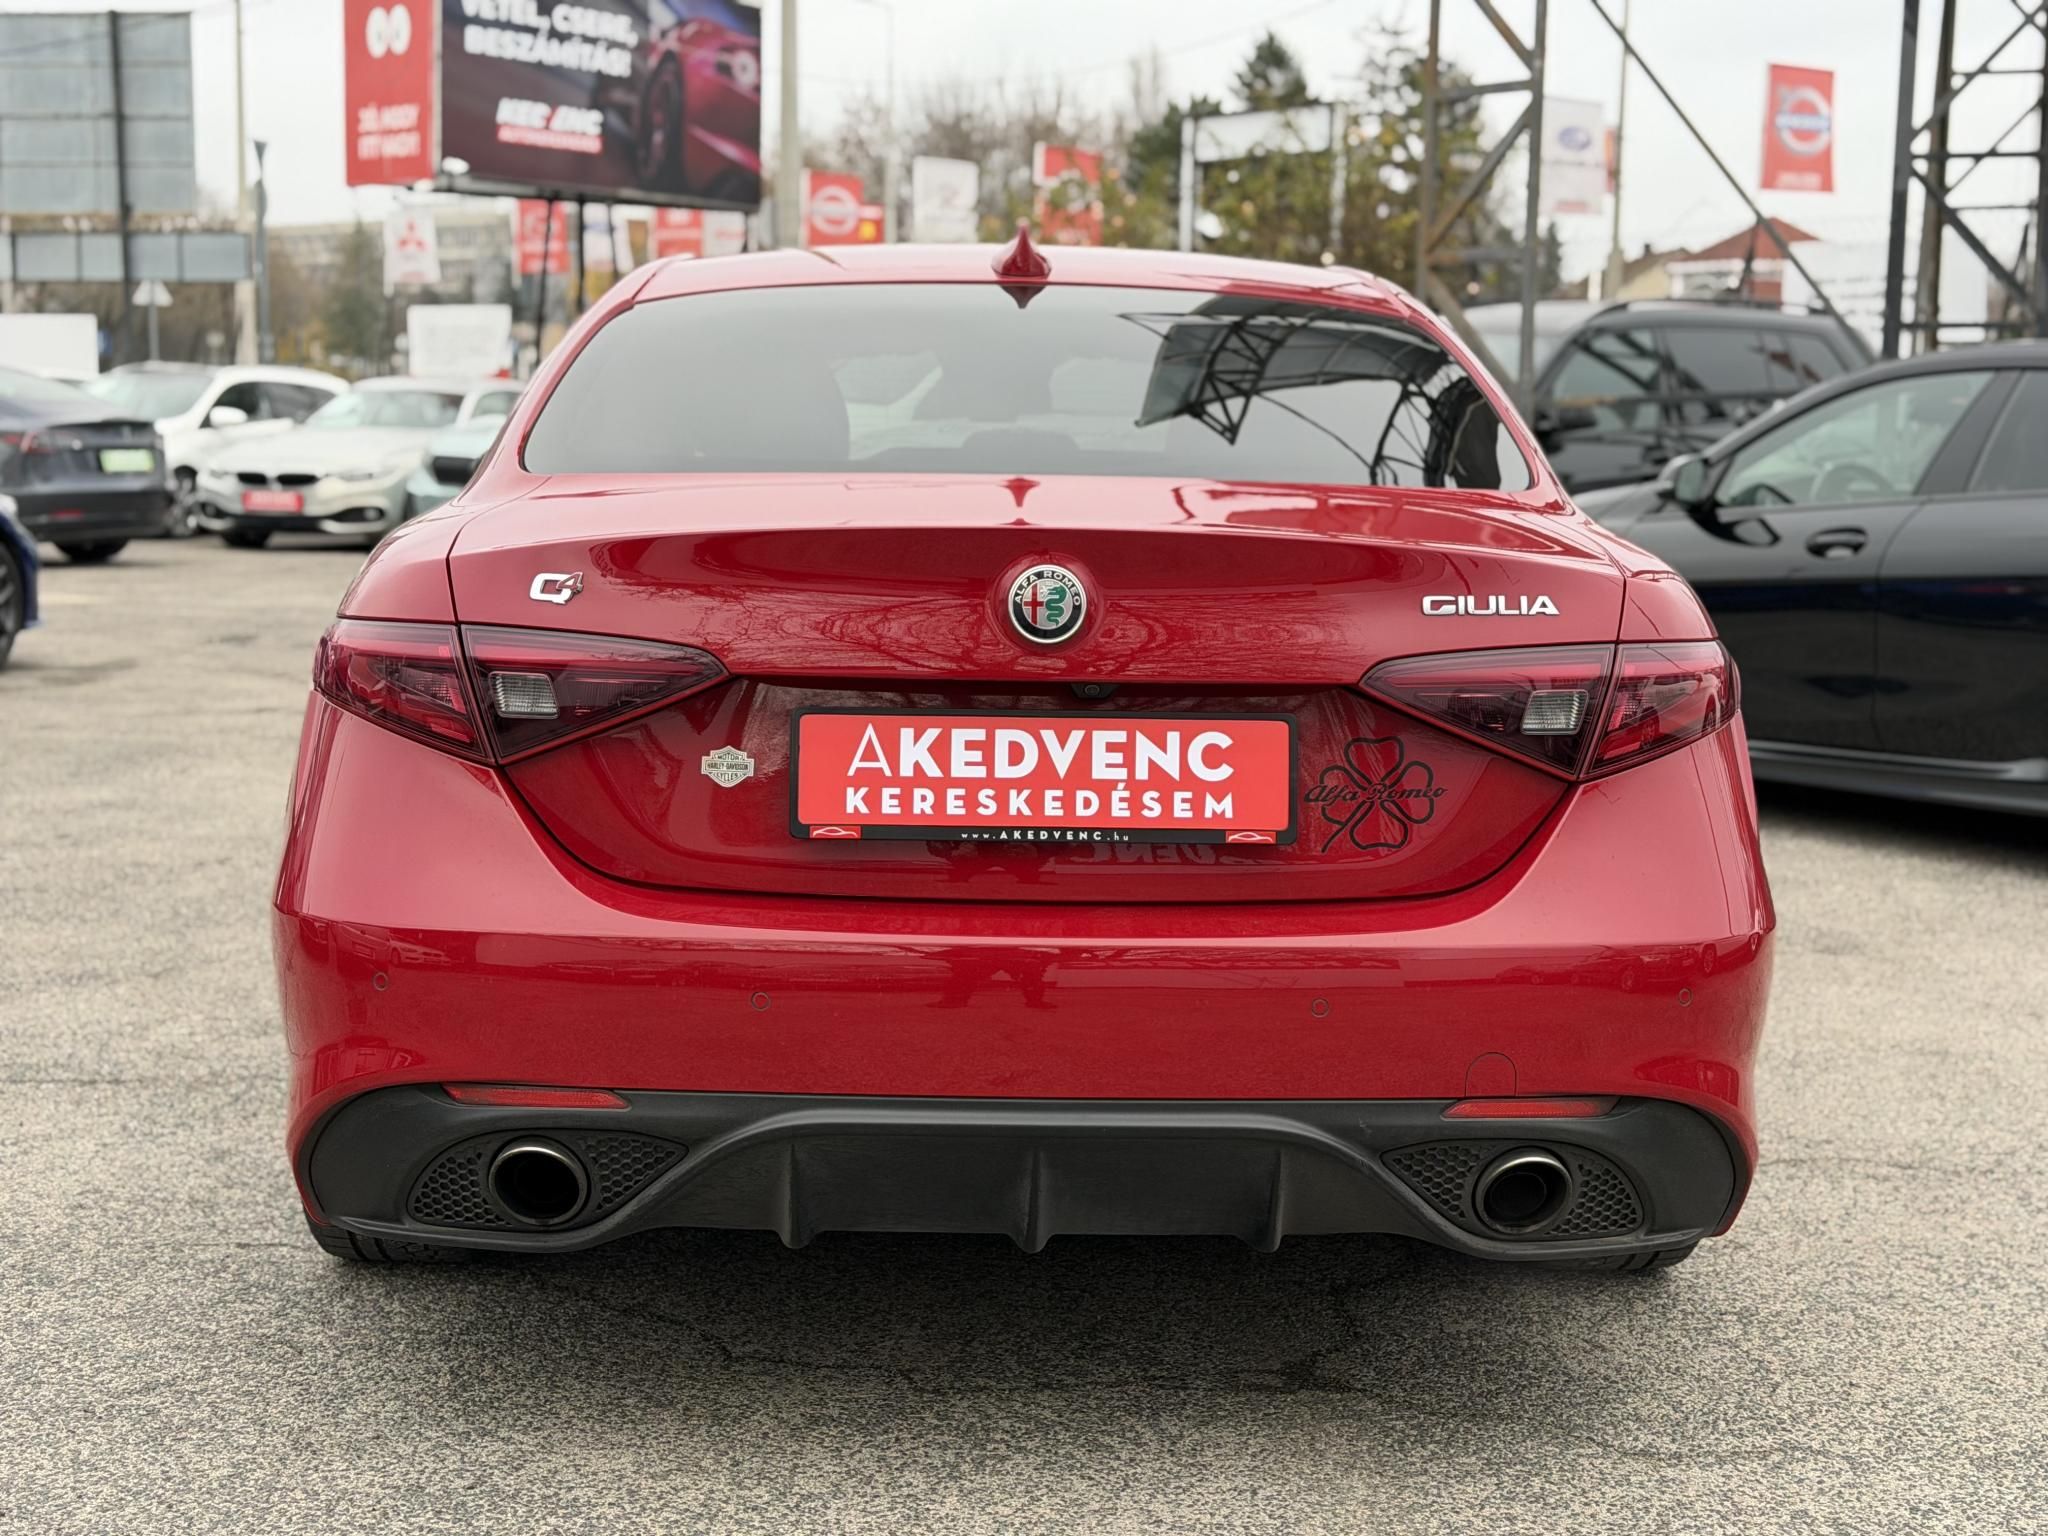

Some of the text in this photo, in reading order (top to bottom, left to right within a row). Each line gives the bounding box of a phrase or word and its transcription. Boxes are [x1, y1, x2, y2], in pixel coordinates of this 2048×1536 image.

[1014, 570, 1081, 606] ALFA ROMEO
[1422, 595, 1560, 615] GIULIA
[846, 722, 1235, 782] AKEDVENC
[845, 781, 1233, 819] KERESKEDÉSEM
[1304, 782, 1449, 807] Alfa Romeo
[961, 830, 1129, 841] www.AKEDVENC.hu
